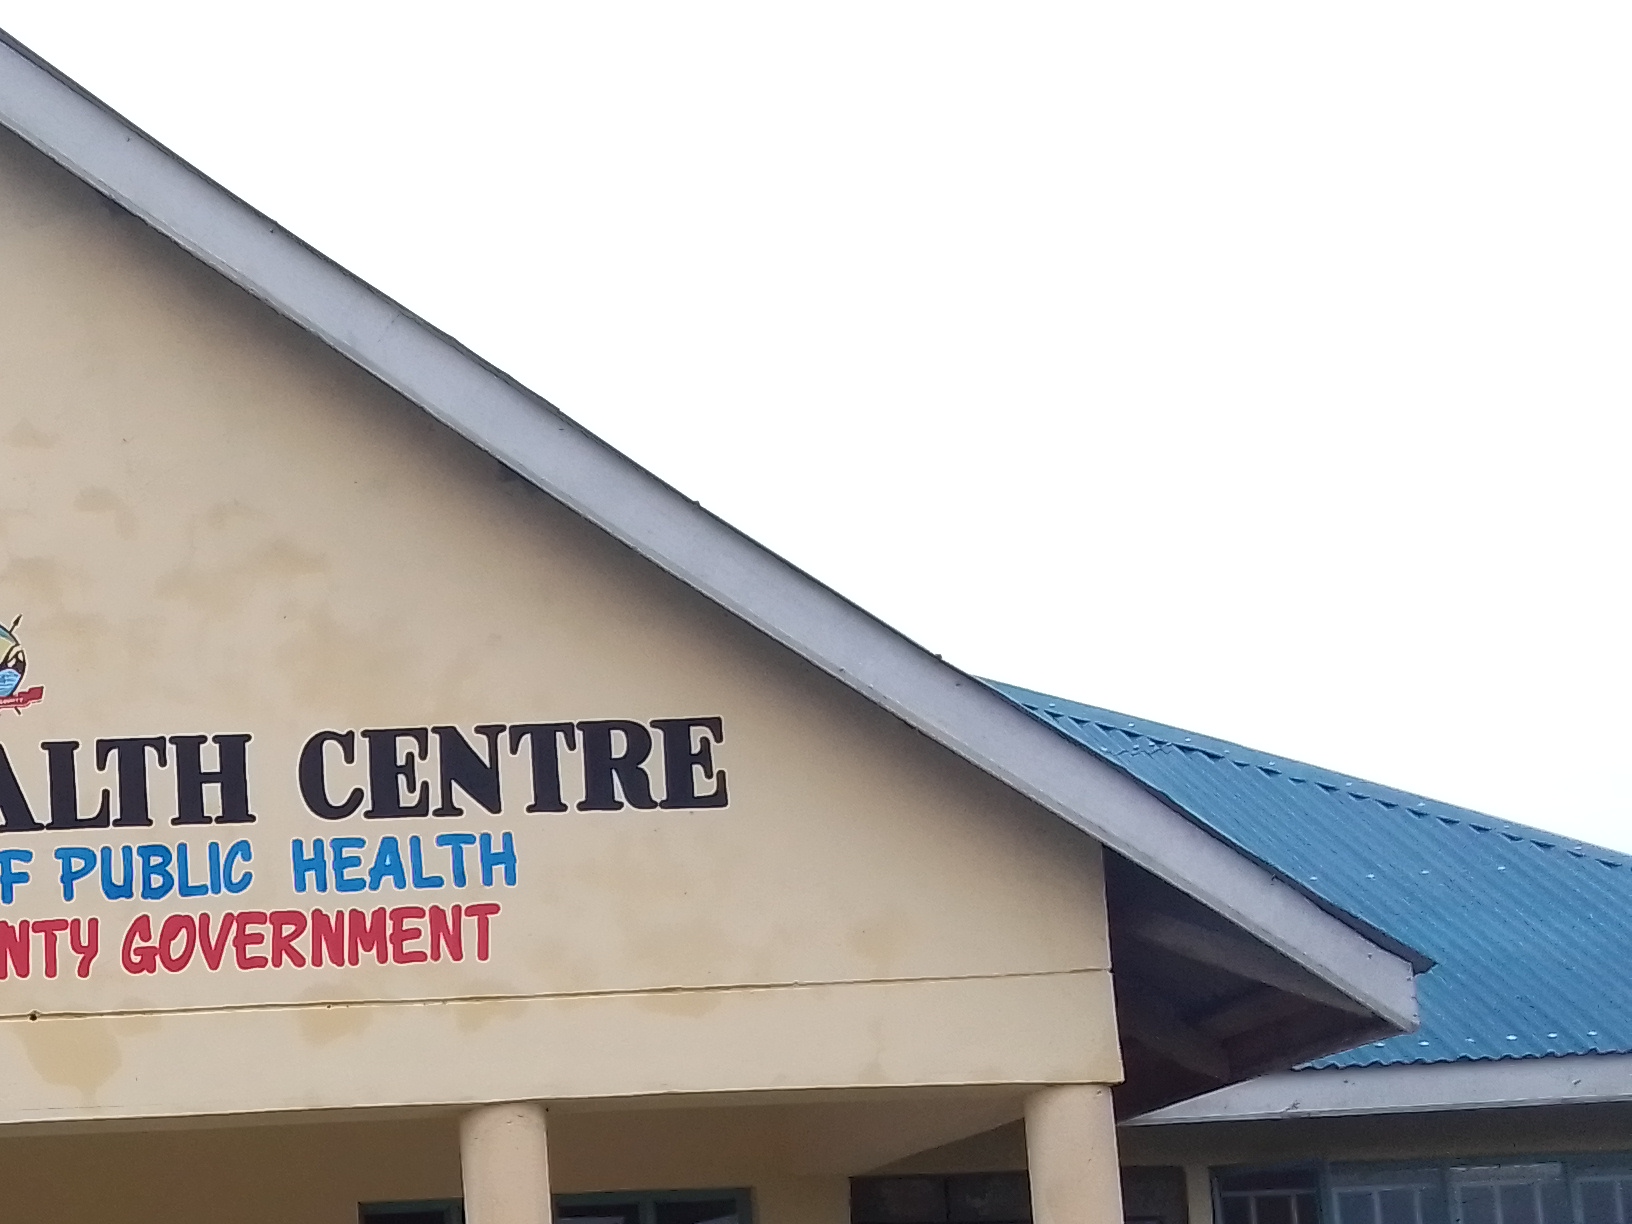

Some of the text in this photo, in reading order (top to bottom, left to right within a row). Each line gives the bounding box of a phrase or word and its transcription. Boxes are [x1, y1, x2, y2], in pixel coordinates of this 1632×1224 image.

[298, 716, 729, 821] CENTRE
[54, 839, 253, 901] PUBLIC
[291, 832, 517, 893] HEALTH
[121, 903, 501, 975] GOVERNMENT
